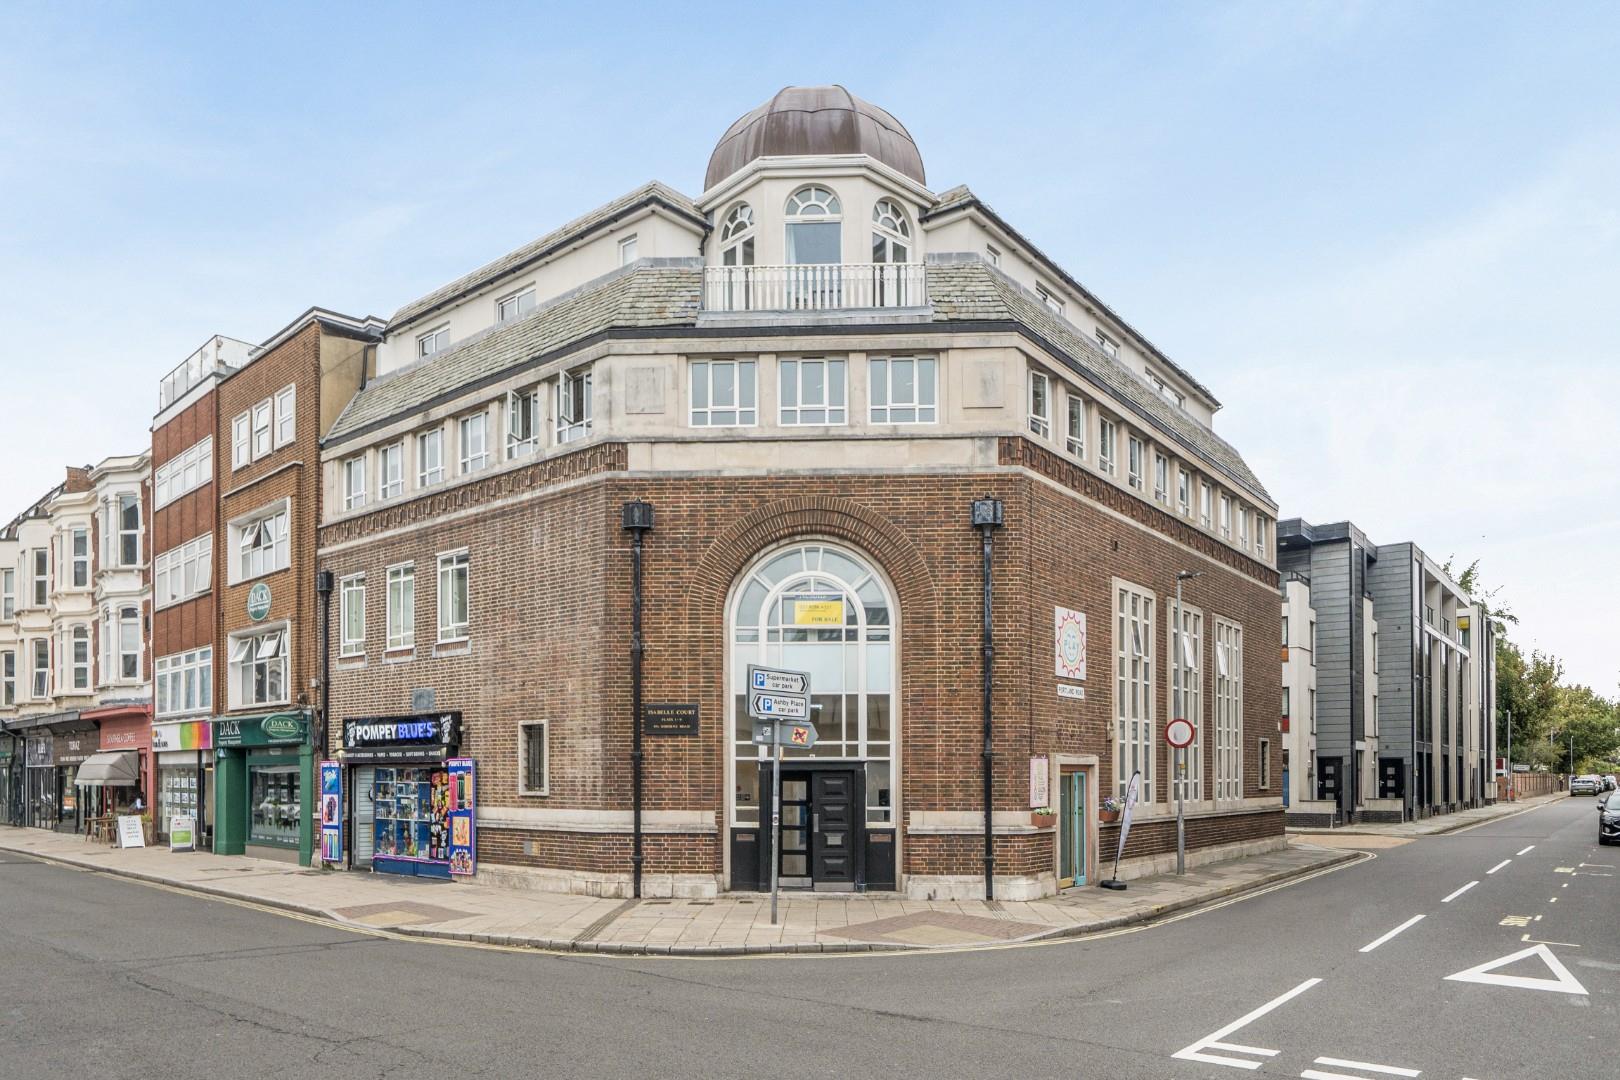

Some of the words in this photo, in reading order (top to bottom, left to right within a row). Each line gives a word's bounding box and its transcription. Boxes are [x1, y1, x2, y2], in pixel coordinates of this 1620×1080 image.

[766, 673, 799, 683] Supermarket
[773, 698, 789, 707] Ashby
[220, 720, 241, 736] DACK
[271, 720, 294, 728] DACK
[356, 724, 397, 740] POMPEY
[397, 722, 433, 738] BLUE'S
